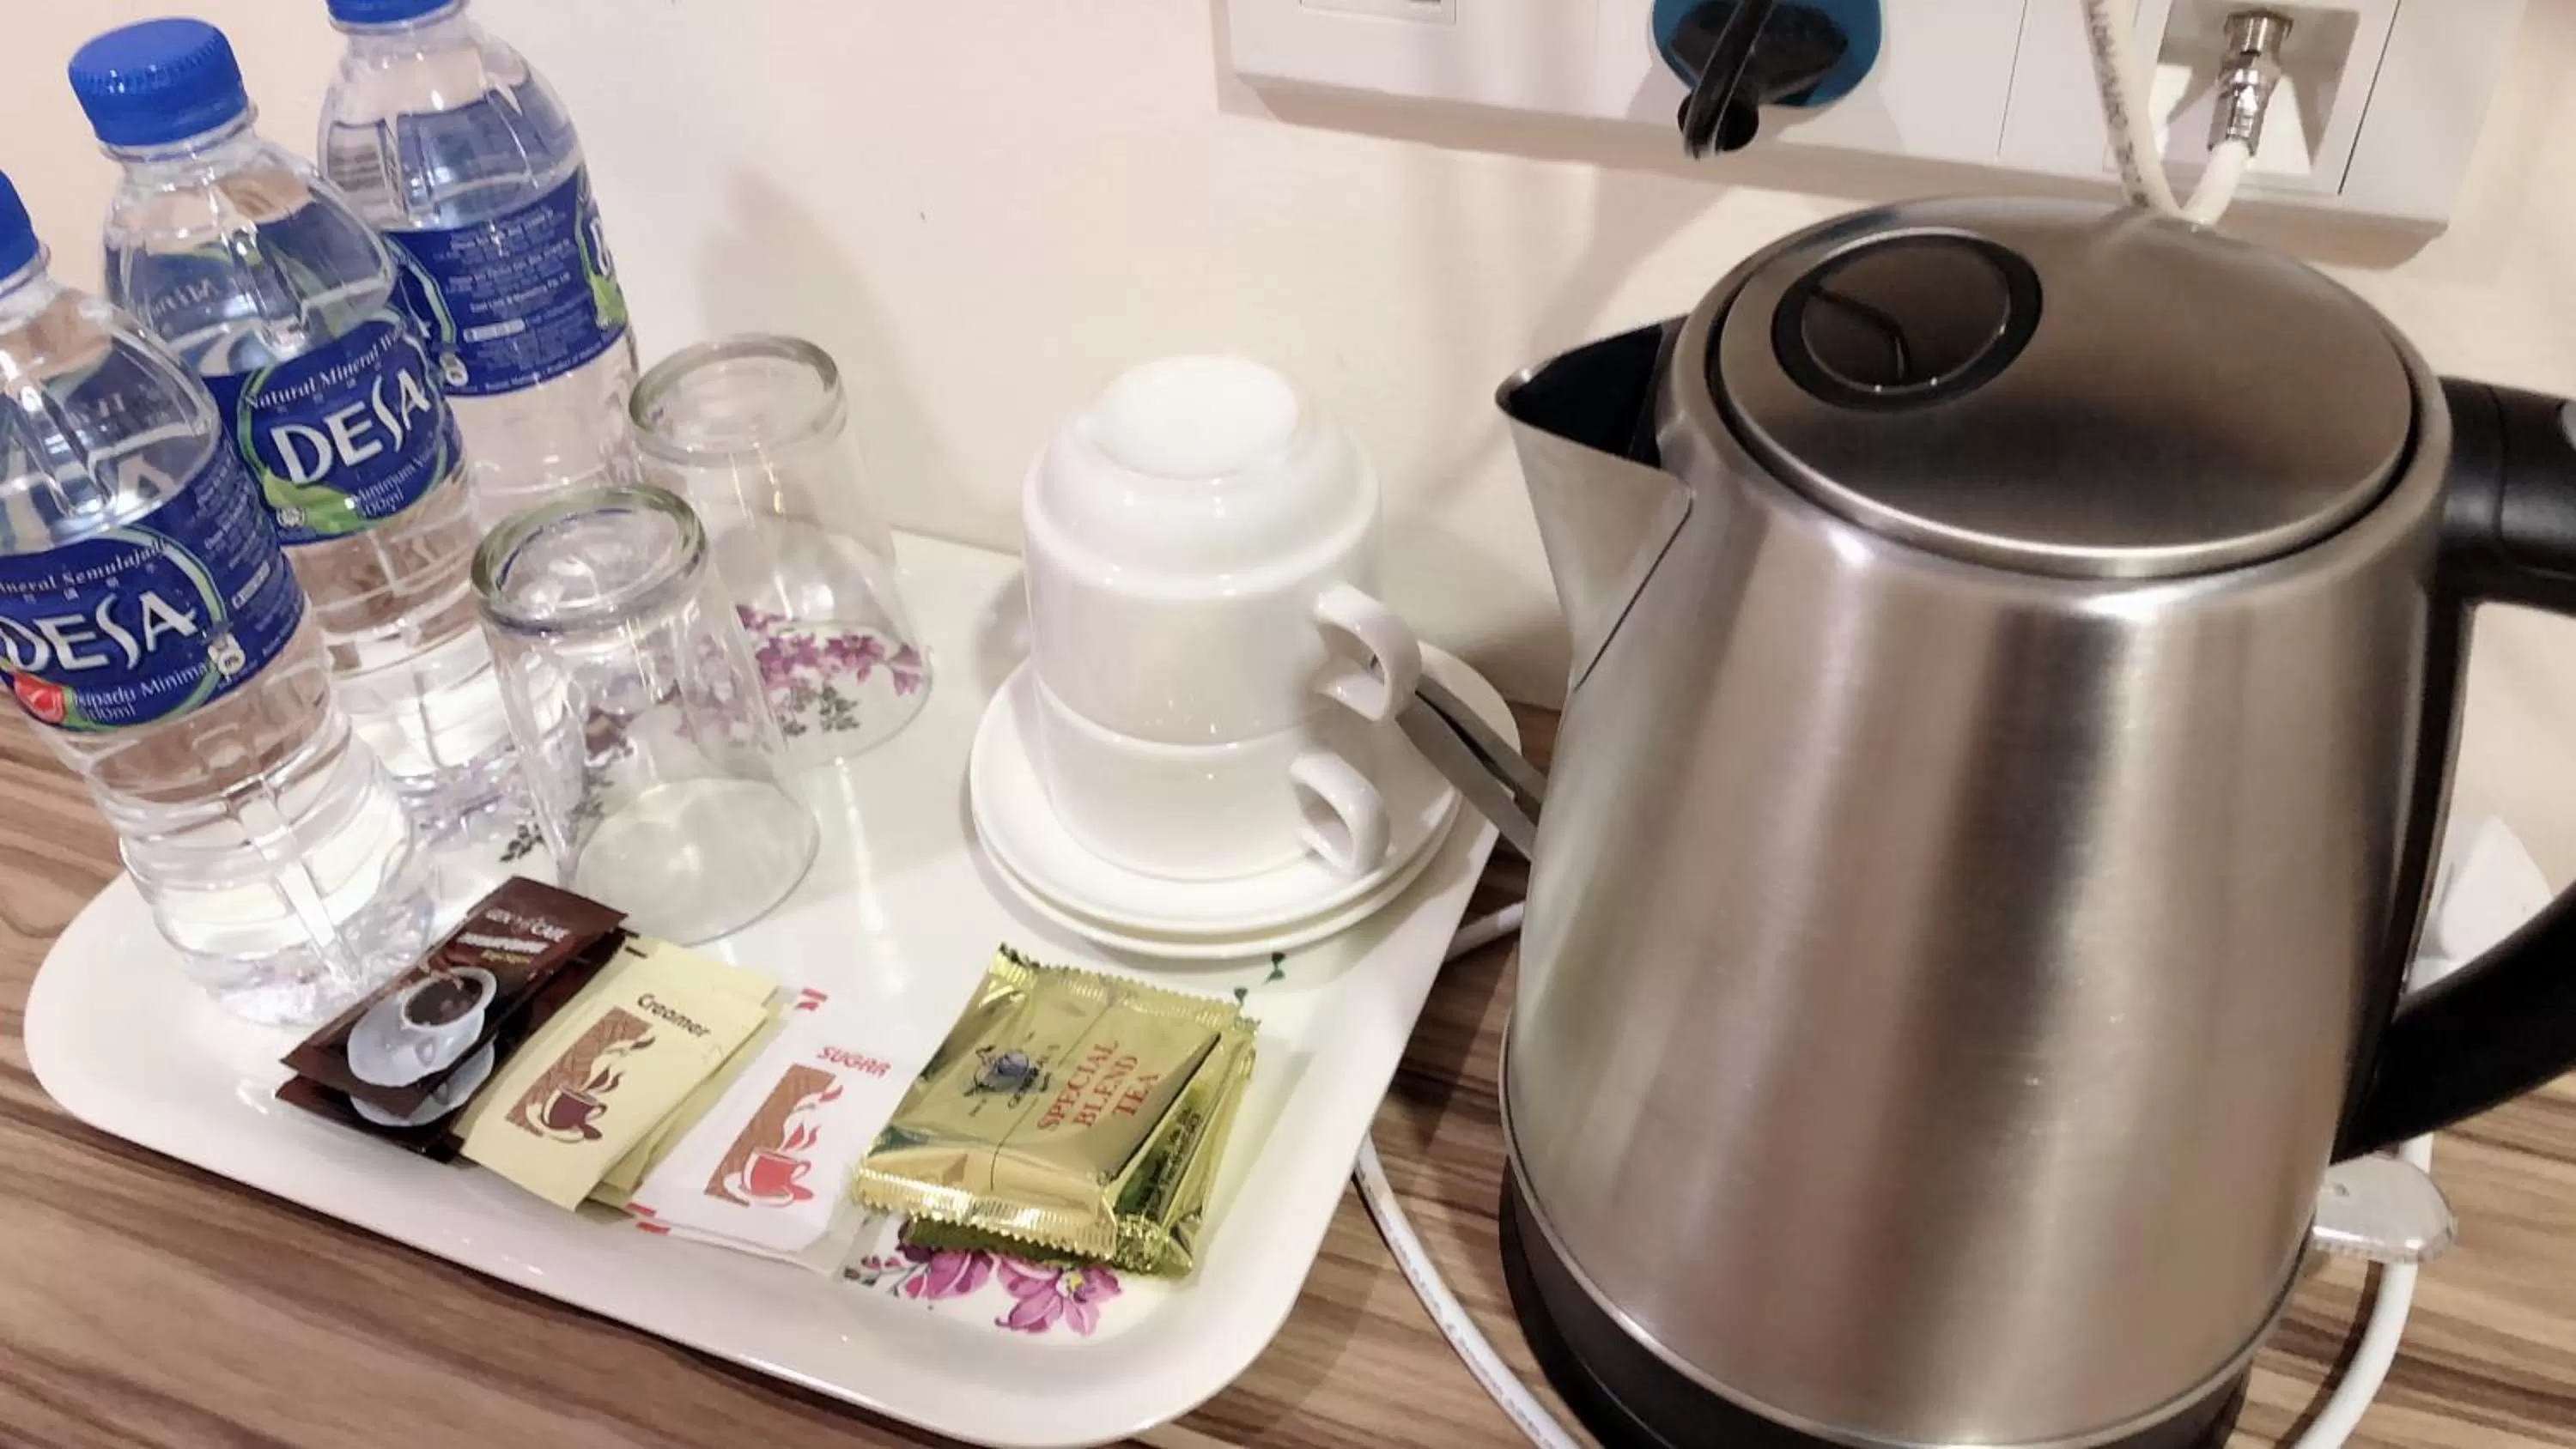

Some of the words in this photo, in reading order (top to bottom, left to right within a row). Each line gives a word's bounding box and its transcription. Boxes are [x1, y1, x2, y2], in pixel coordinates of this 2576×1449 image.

[319, 343, 379, 388] Mineral
[271, 368, 430, 484] DESA
[0, 591, 197, 671] DESA
[636, 992, 711, 1038] Creamer
[817, 1045, 891, 1078] SUGAR
[1037, 1039, 1120, 1132] SPECIAL
[1073, 1053, 1139, 1128] BLEND
[1113, 1071, 1162, 1118] TEA
